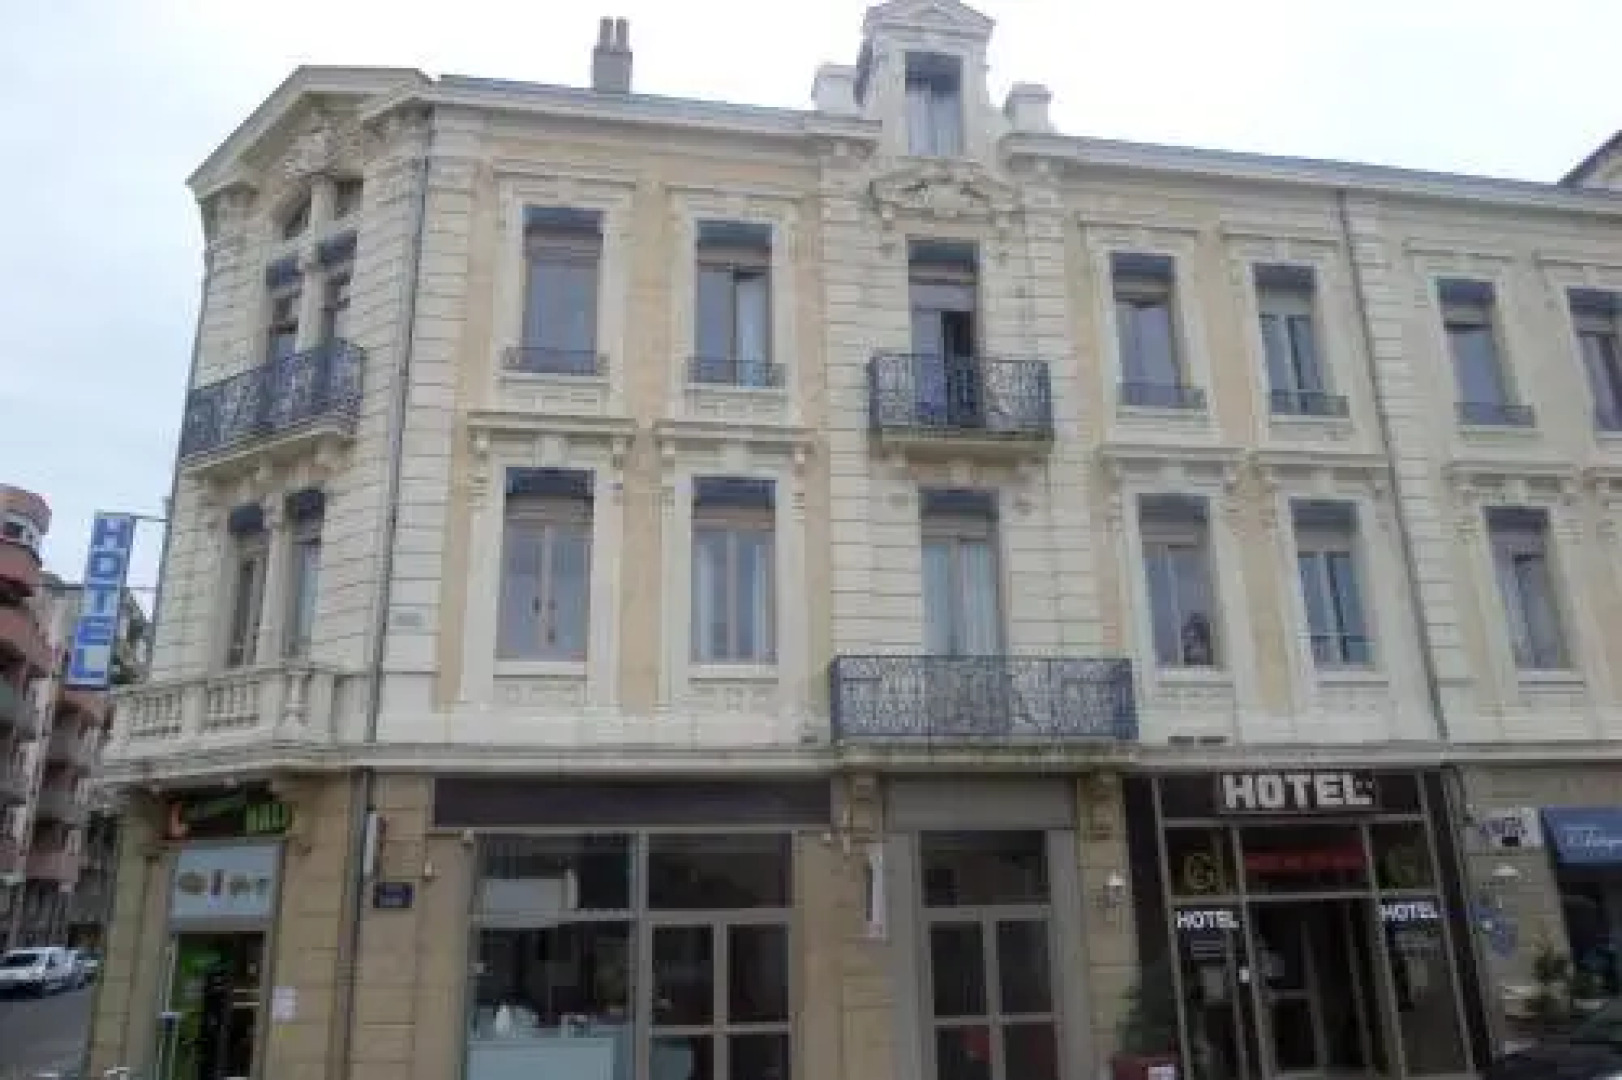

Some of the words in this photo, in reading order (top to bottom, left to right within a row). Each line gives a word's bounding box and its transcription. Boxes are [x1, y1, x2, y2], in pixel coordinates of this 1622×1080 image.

[71, 518, 133, 679] HOTEL
[1222, 774, 1373, 808] HOTEL
[1177, 911, 1239, 928] HOTEL
[1381, 903, 1438, 921] HOTEL
